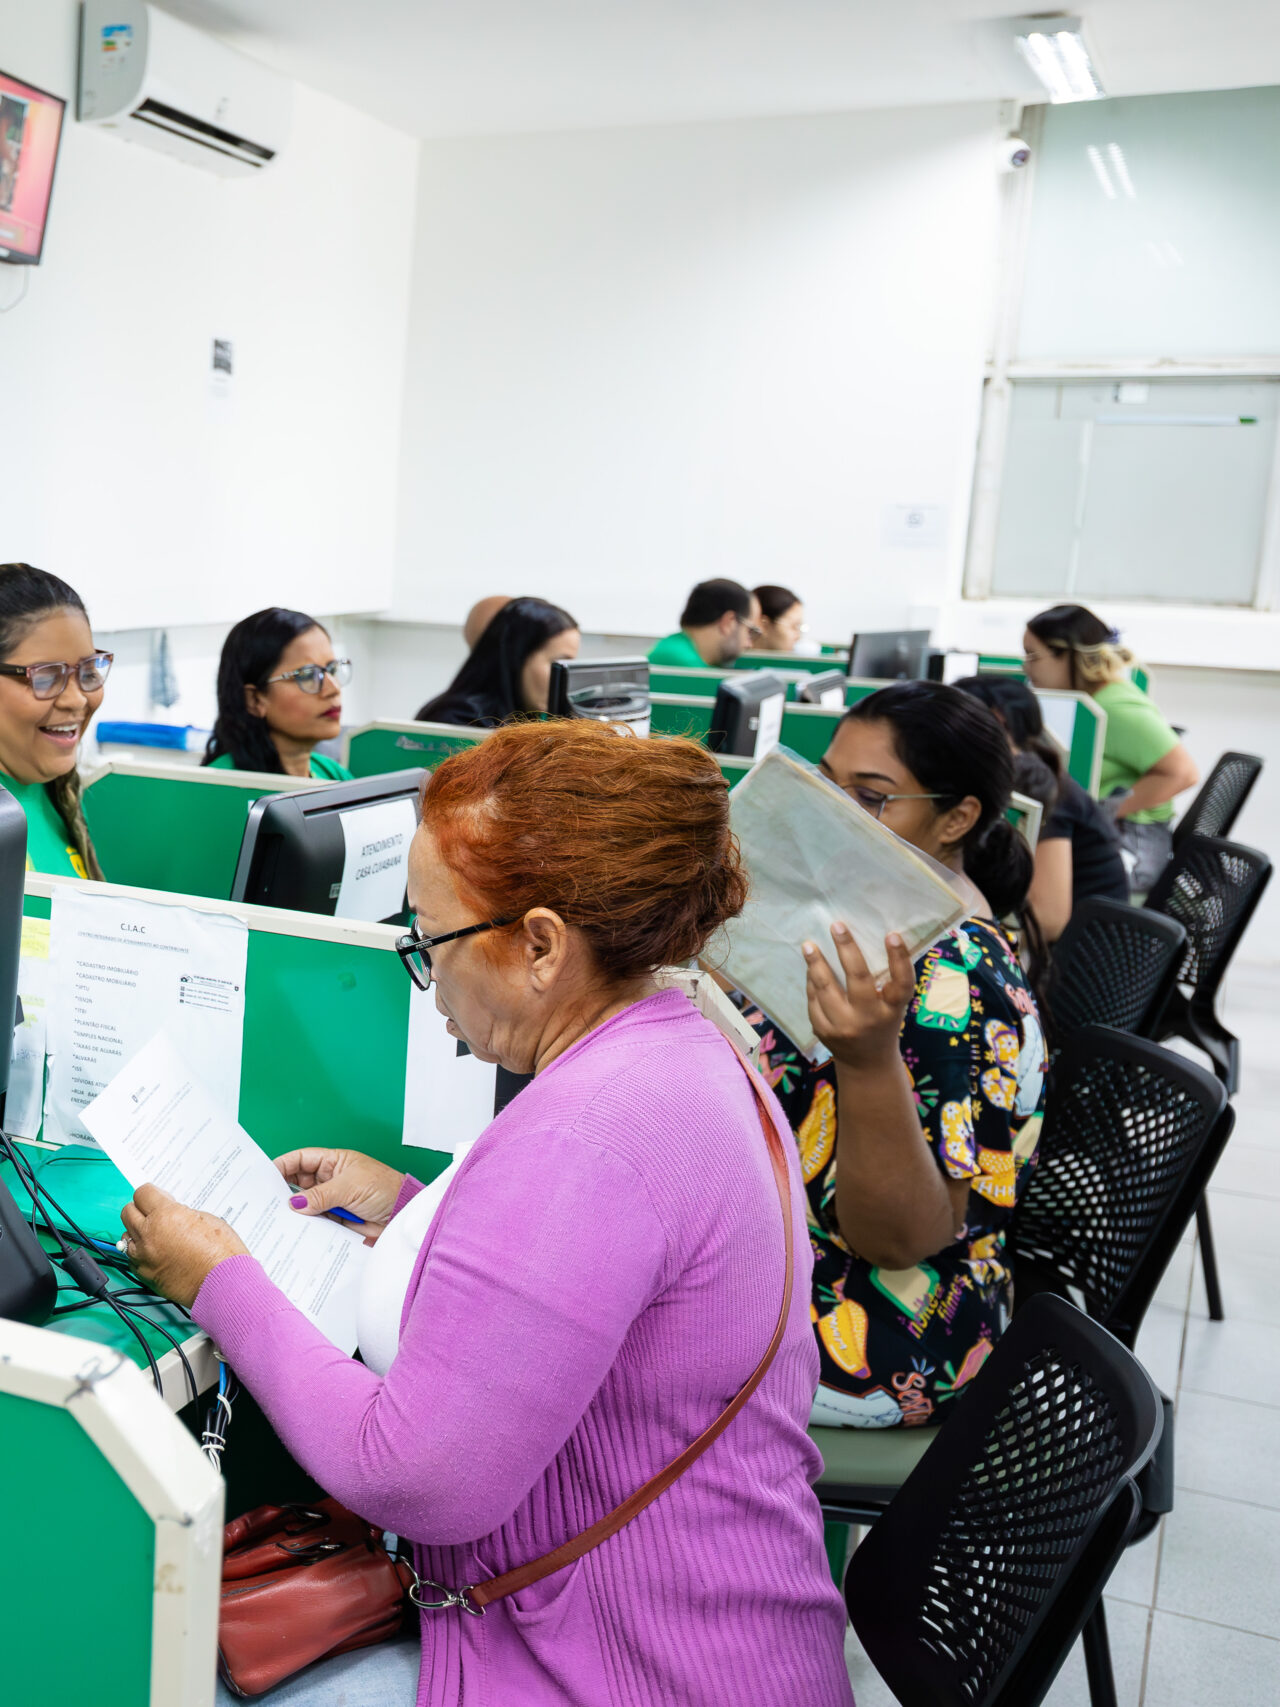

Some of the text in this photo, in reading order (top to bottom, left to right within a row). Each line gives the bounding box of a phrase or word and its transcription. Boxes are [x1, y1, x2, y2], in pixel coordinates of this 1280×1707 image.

[362, 833, 403, 856] ATENDIMENTO
[356, 855, 402, 880] CASA CUIABANA
[120, 923, 146, 934] C.I.A.C
